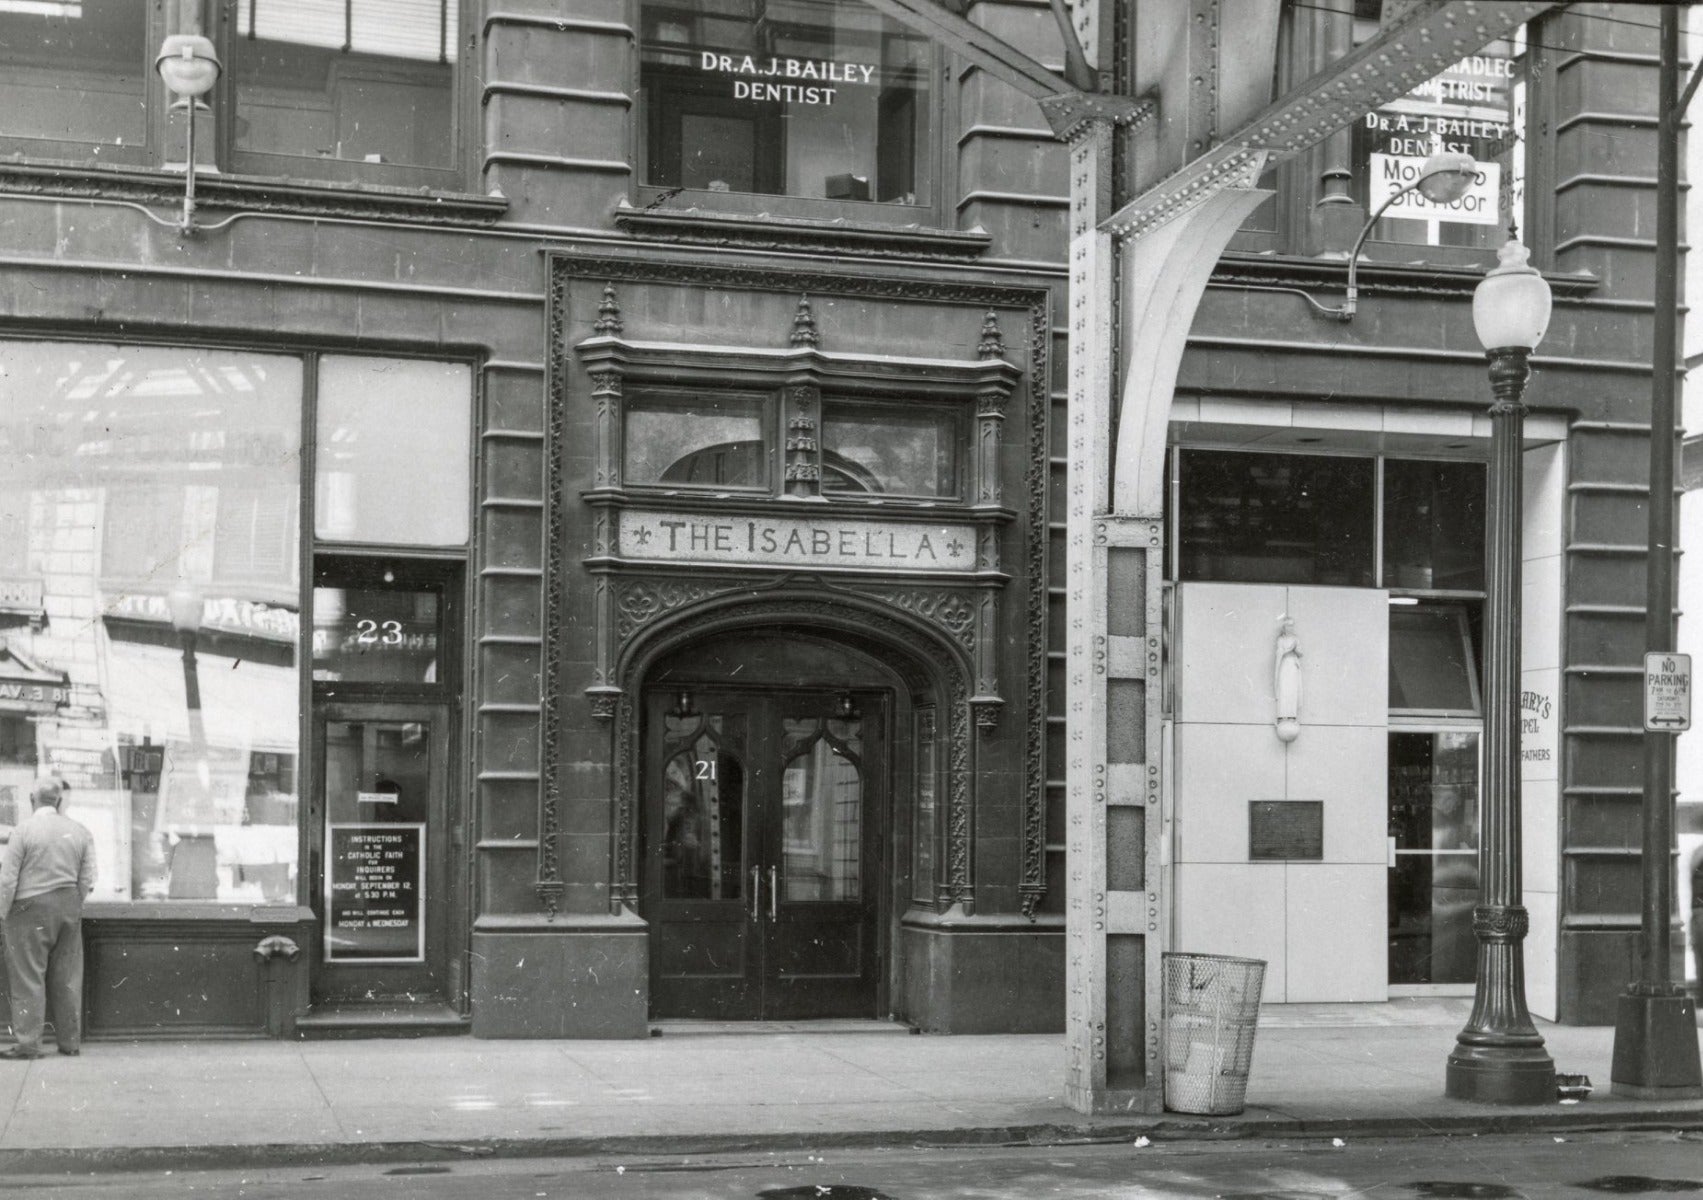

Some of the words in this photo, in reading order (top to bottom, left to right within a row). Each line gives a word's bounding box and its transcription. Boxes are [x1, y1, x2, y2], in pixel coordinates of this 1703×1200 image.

[734, 81, 836, 105] DENTIST
[1390, 137, 1471, 157] DENTIST
[660, 521, 732, 551] THE
[748, 522, 937, 559] ISABELLA
[356, 619, 403, 644] 23
[1662, 661, 1676, 673] NO
[1648, 674, 1689, 686] PARKING
[1521, 719, 1539, 734] PEL
[695, 760, 716, 780] 21
[385, 851, 404, 859] FAITH
[356, 866, 395, 874] INQUIRERS
[361, 882, 400, 890] SEPTEMBER
[372, 920, 409, 928] WEDNESDAY
